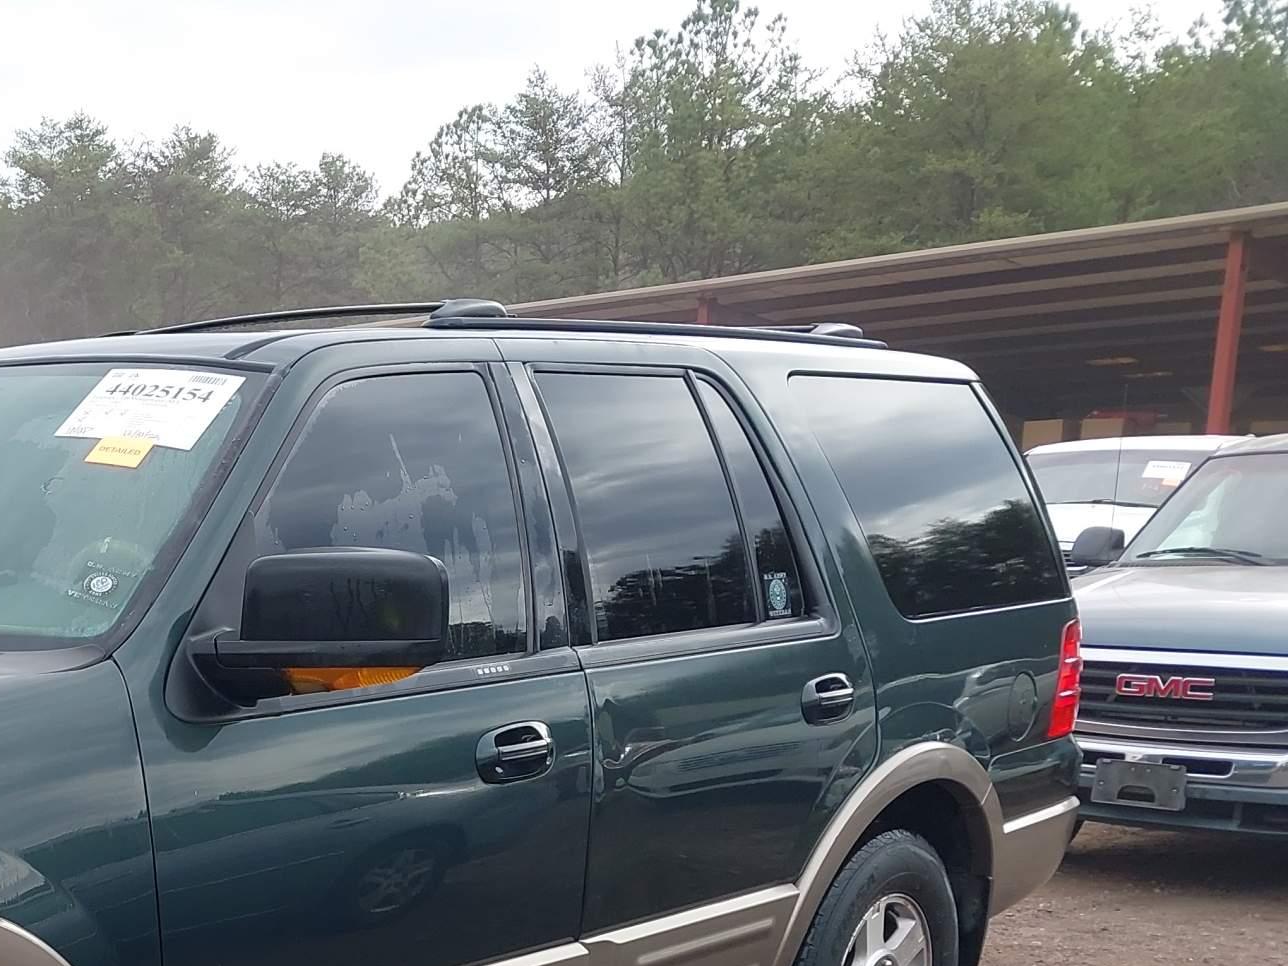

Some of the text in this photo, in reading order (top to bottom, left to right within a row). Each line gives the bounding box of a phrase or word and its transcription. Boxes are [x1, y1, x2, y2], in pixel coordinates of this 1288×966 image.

[105, 383, 214, 403] 44025154
[98, 446, 142, 456] DETAILED
[1115, 673, 1216, 701] GMC
